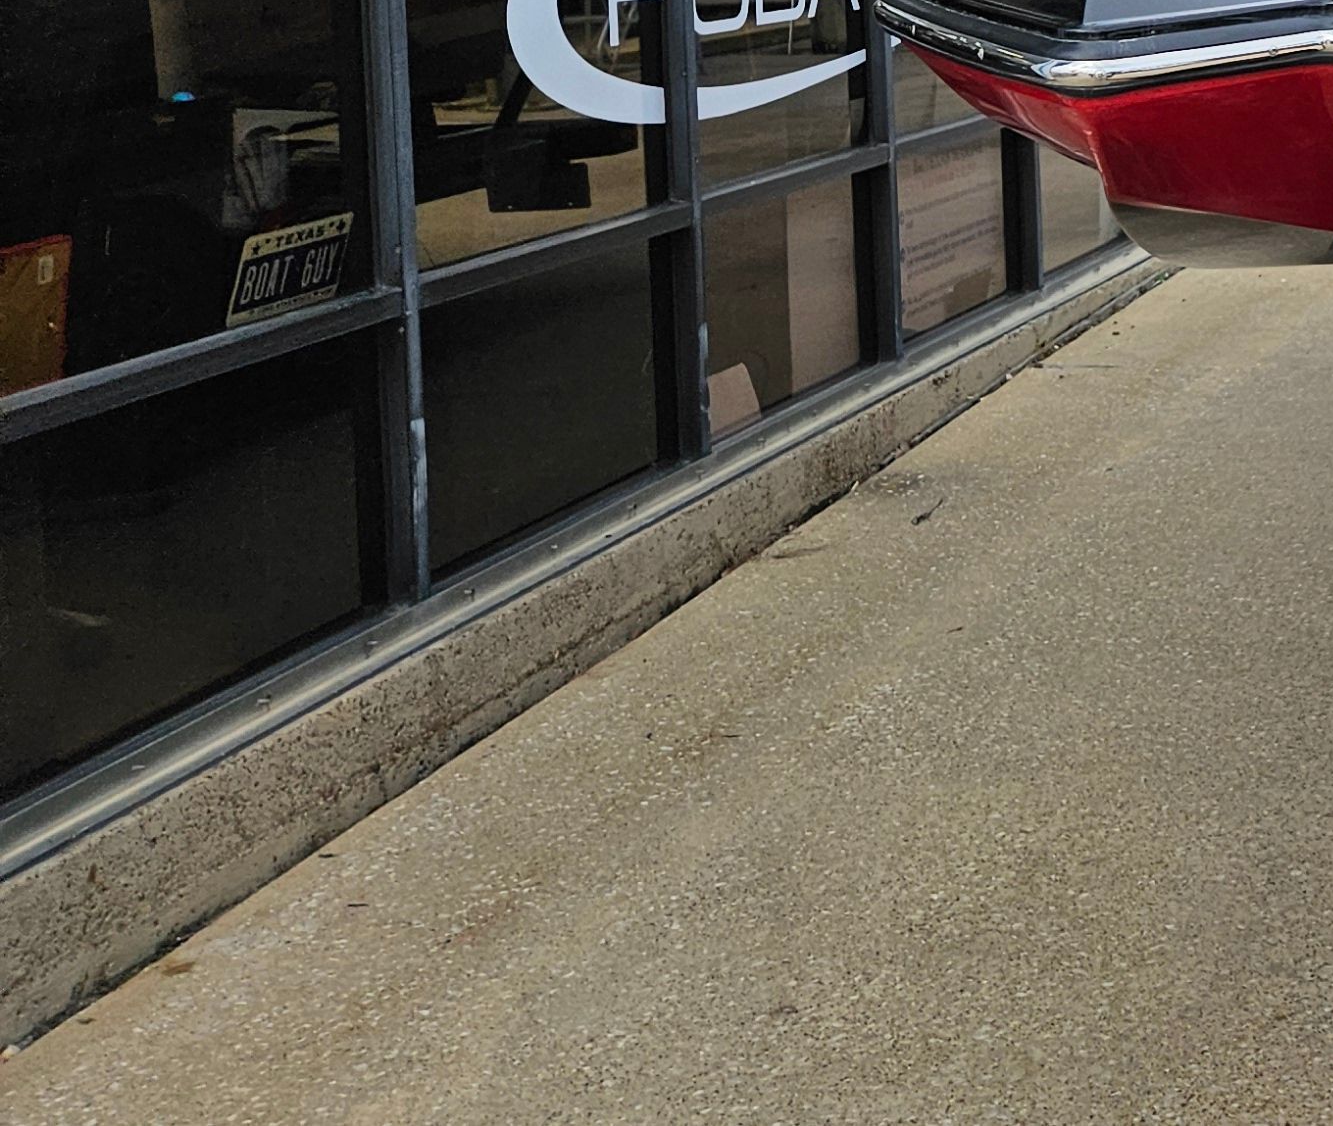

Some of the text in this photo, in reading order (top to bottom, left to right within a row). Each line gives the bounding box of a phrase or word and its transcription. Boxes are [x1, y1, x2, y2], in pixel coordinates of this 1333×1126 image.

[275, 224, 325, 248] TEXAS
[240, 254, 295, 305] BOAT
[301, 241, 340, 289] GUY
